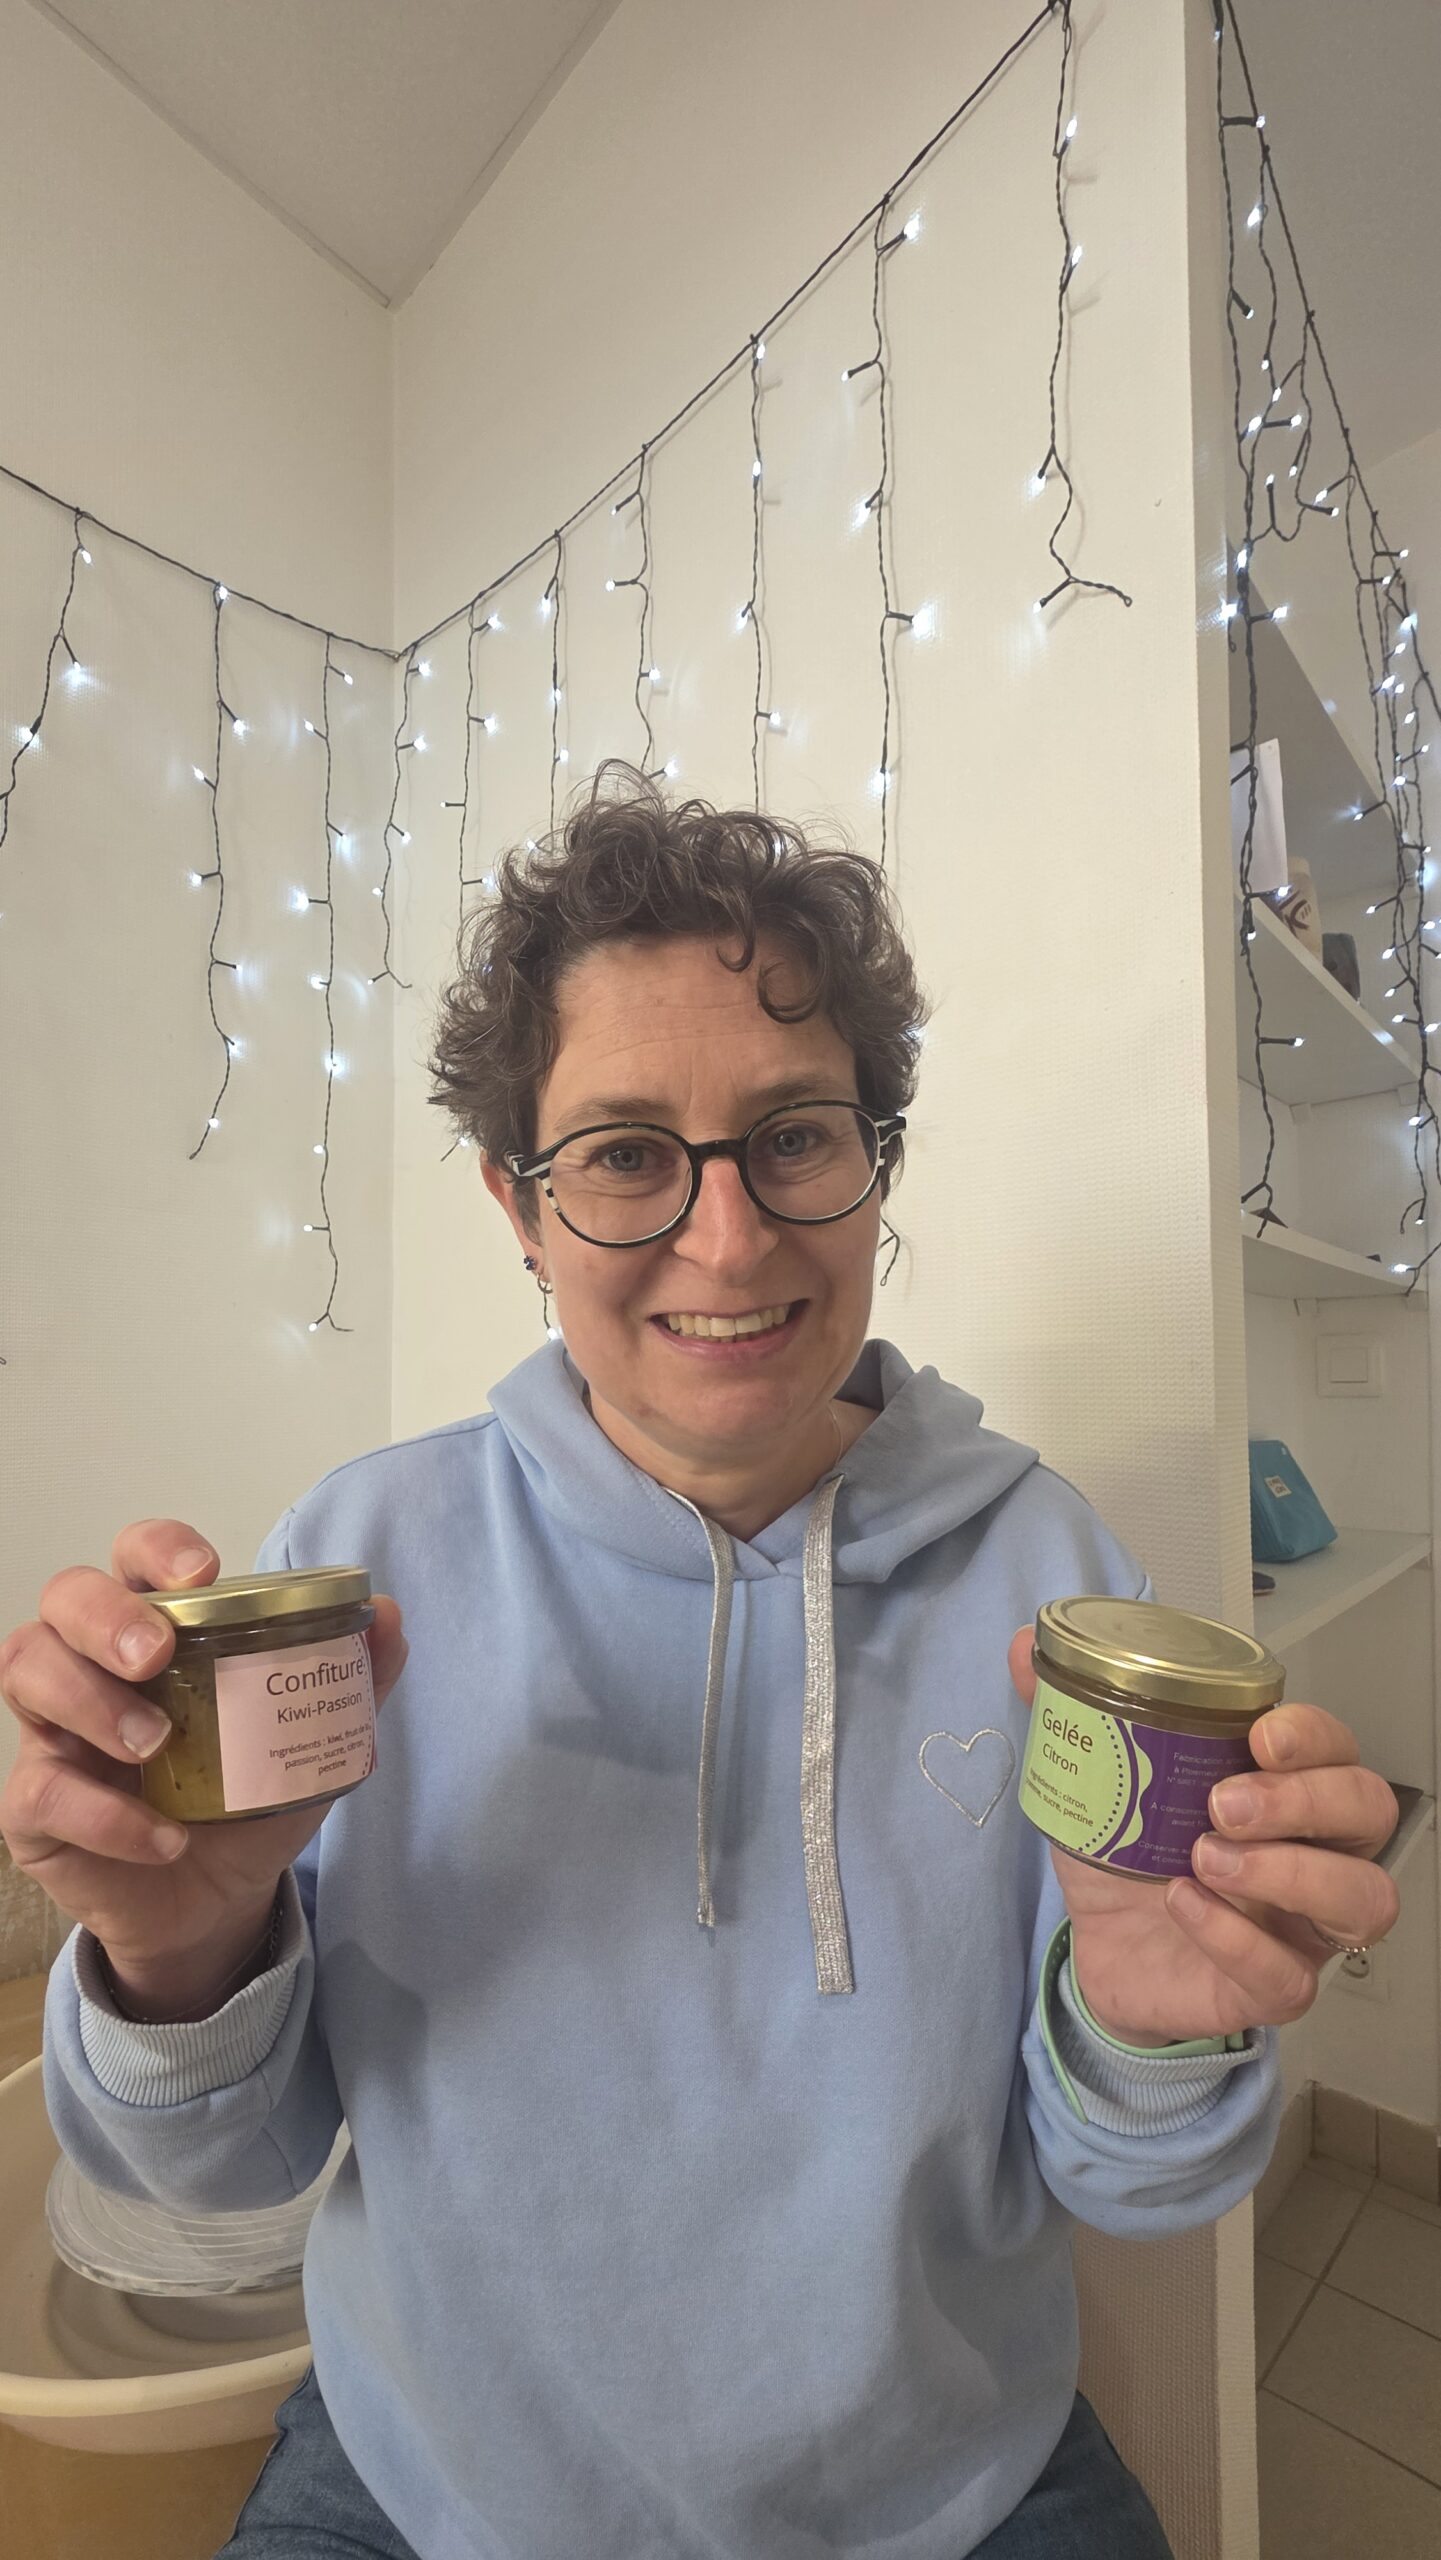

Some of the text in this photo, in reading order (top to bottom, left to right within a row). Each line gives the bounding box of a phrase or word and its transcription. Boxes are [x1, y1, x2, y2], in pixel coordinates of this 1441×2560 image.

[266, 1657, 364, 1696] Confiture
[277, 1690, 362, 1724] Kiwi-Passion
[1042, 1707, 1094, 1753] Gelée
[269, 1738, 321, 1759] Ingrédients
[284, 1752, 322, 1772] passion,
[1042, 1742, 1079, 1776] Citron
[317, 1758, 347, 1776] pectine
[1043, 1794, 1062, 1813] sucre,
[1062, 1807, 1094, 1828] pectine
[1062, 1793, 1088, 1813] citron,
